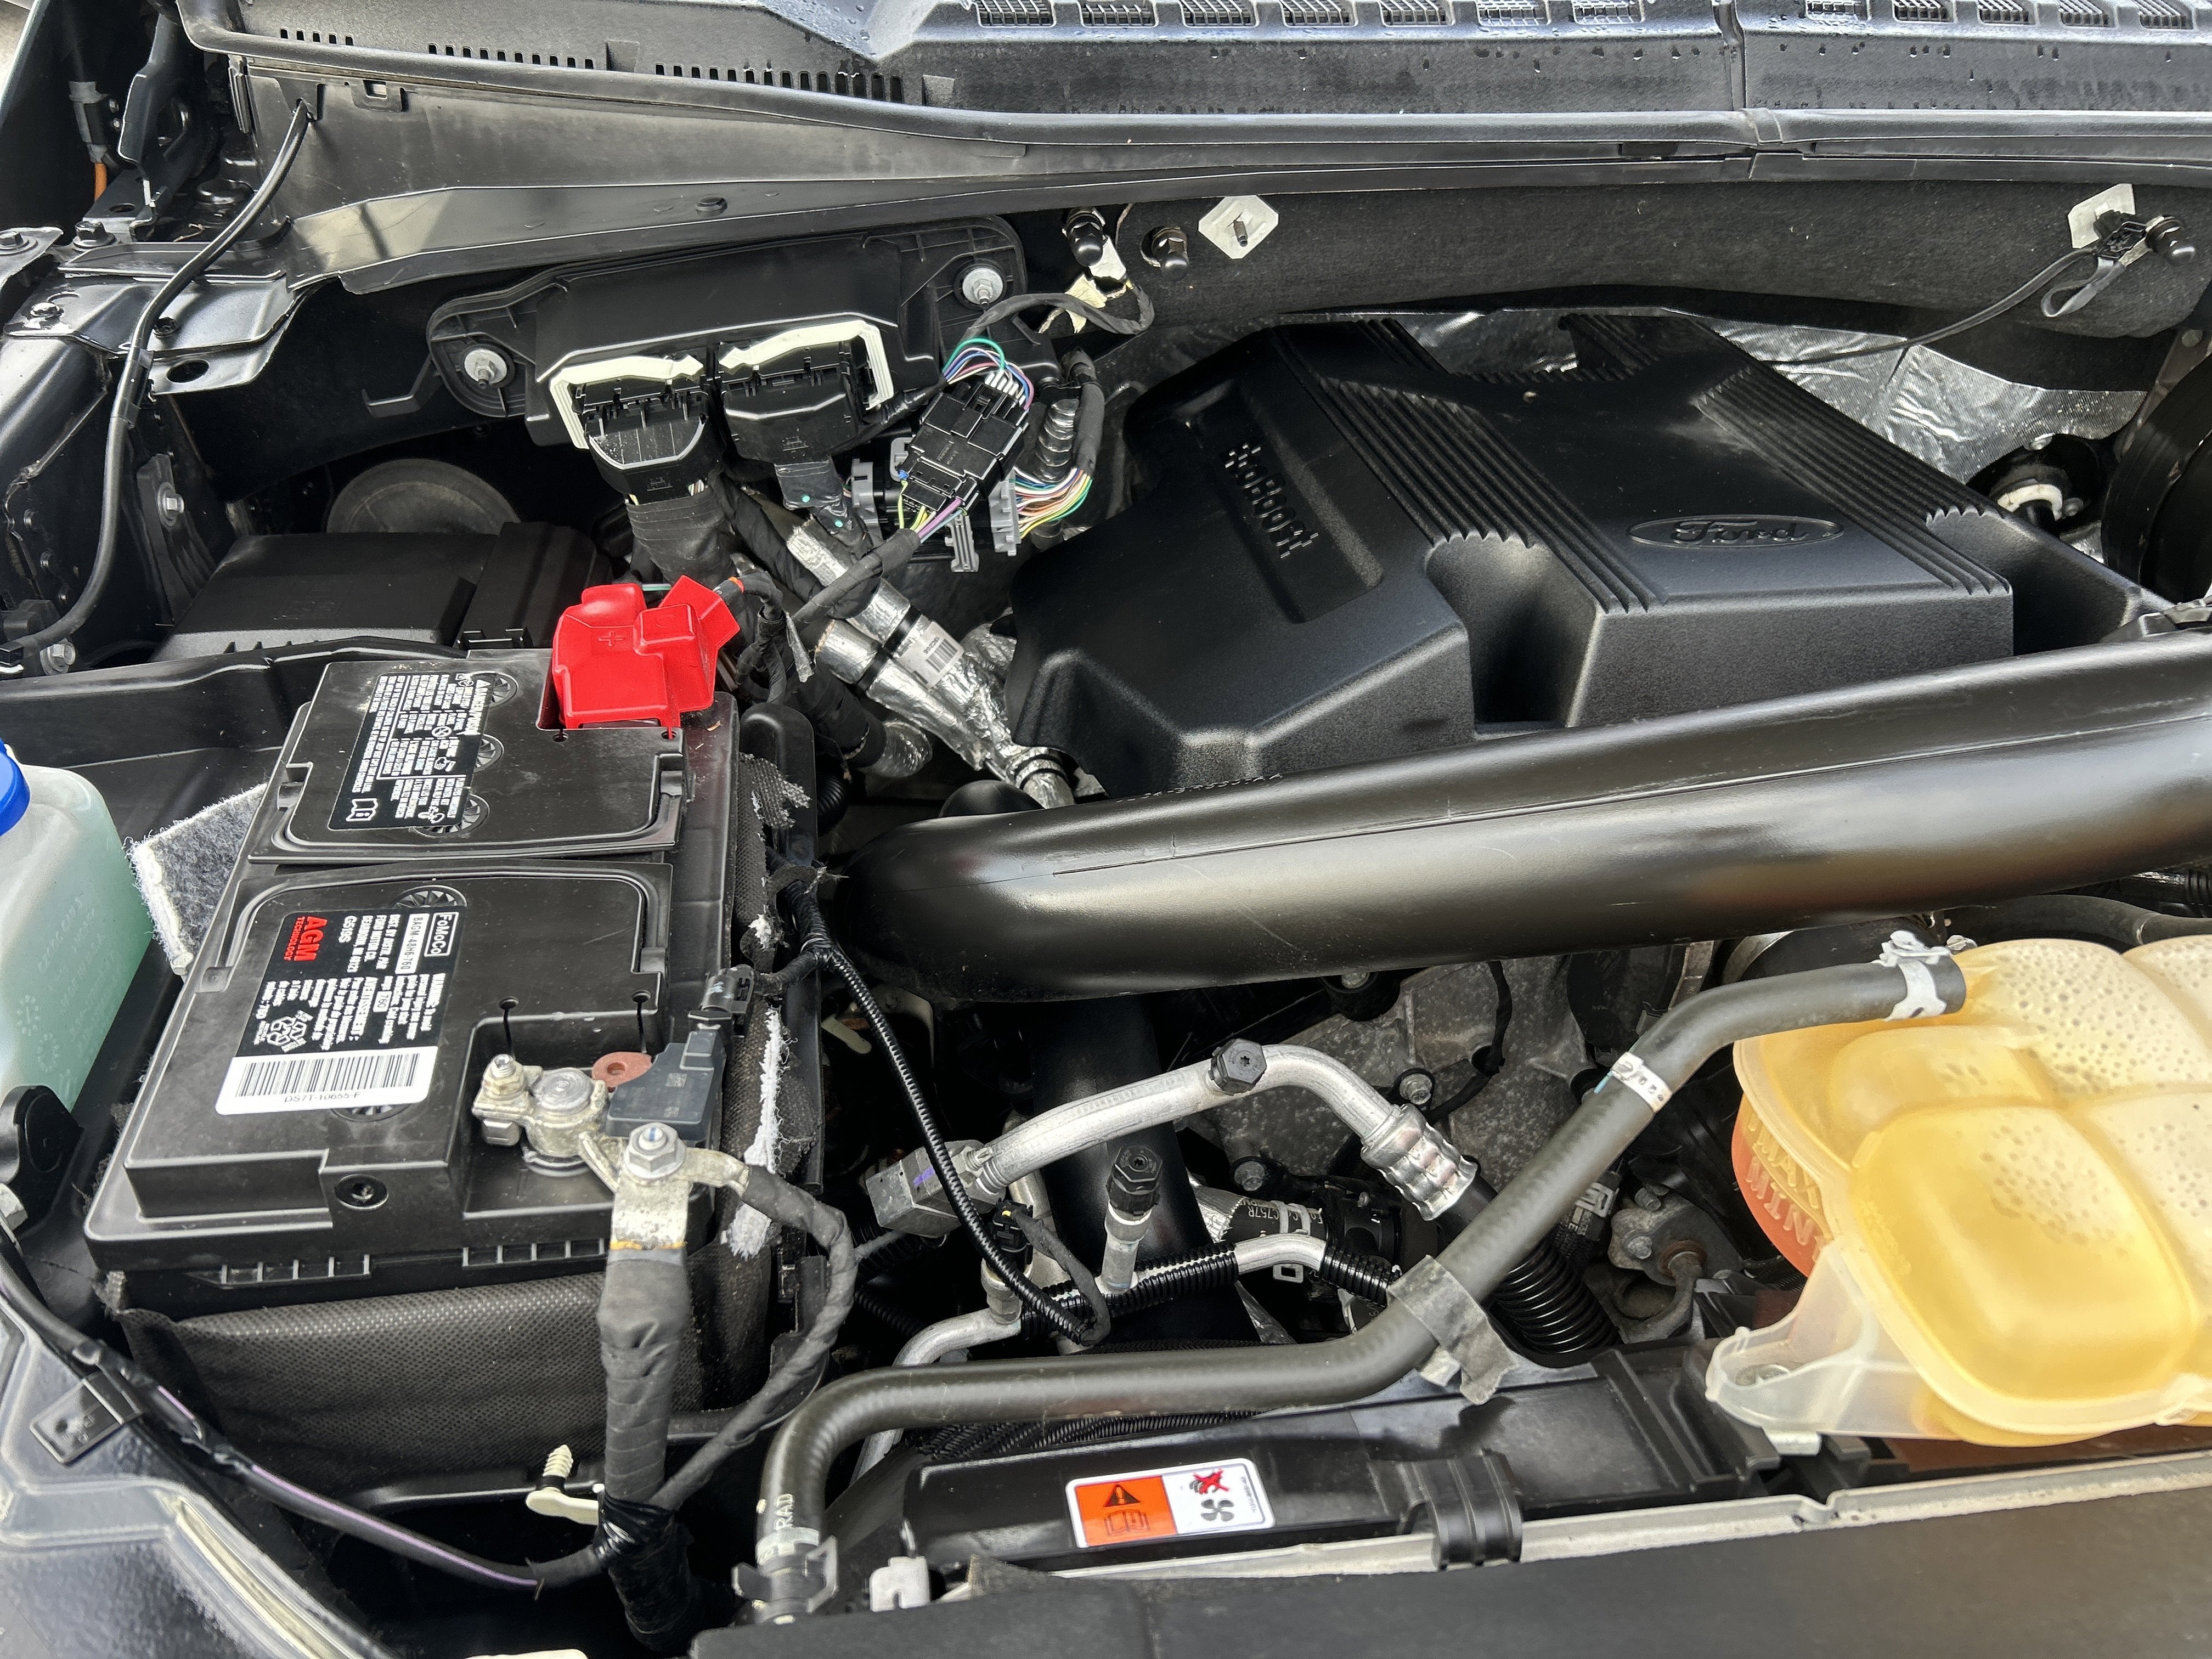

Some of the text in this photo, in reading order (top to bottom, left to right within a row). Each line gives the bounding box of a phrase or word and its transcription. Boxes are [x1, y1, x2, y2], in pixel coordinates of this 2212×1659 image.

[1671, 519, 1809, 544] Ford
[282, 916, 306, 961] TECHNOLOGY
[292, 916, 329, 961] AGM
[337, 916, 358, 943] G519S
[373, 915, 387, 929] FORD
[429, 914, 452, 954] FoMoCo
[400, 917, 424, 969] BAGM-48H6-760
[349, 977, 378, 1035] AVERTISSEMENT
[377, 995, 388, 1007] 760
[775, 1493, 795, 1530] RAD
